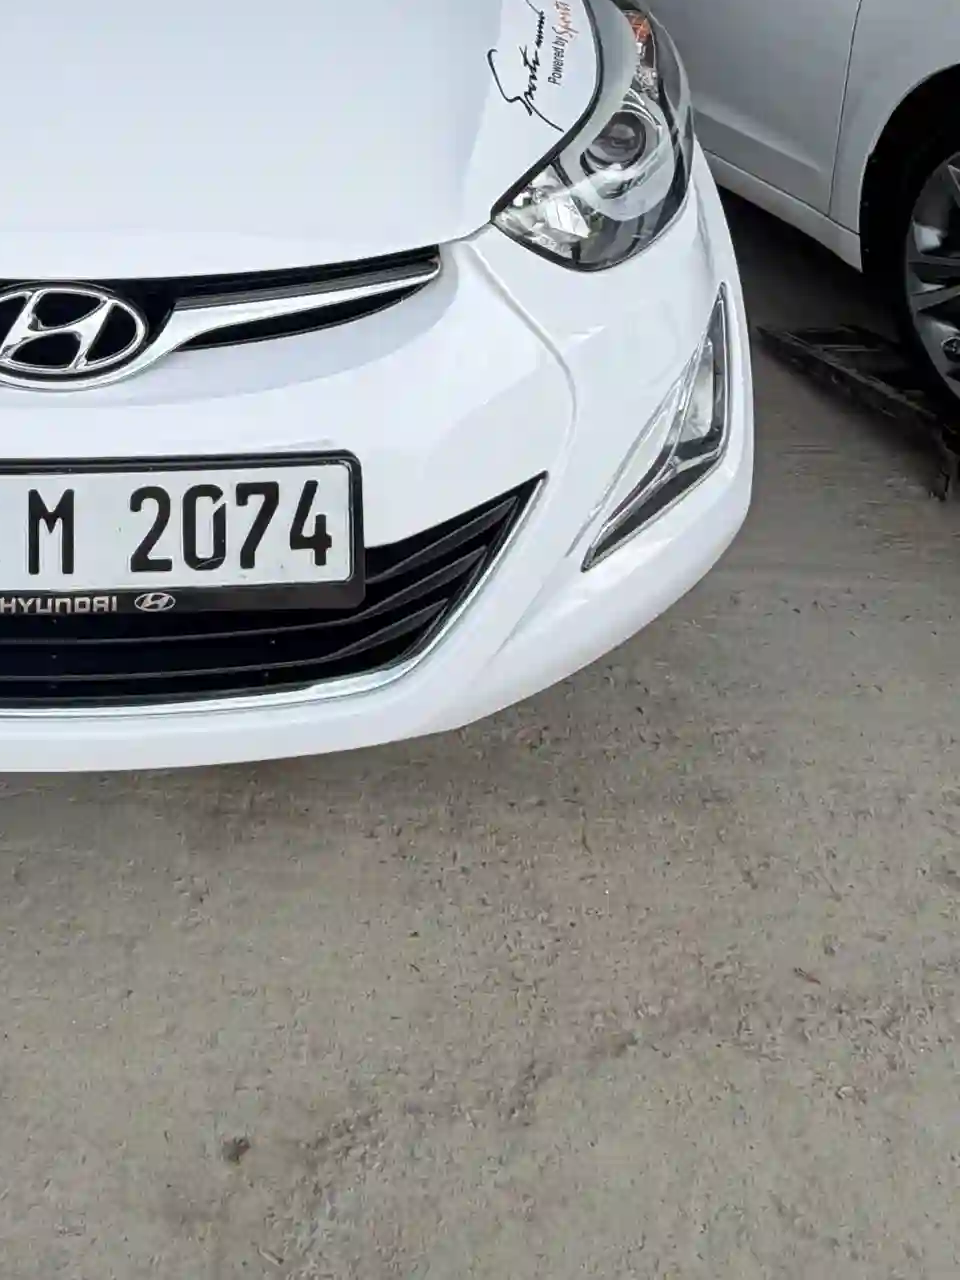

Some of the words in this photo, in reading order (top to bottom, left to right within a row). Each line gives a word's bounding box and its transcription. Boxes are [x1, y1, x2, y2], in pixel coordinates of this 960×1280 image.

[547, 48, 566, 86] Powered
[28, 489, 75, 575] M
[129, 480, 333, 573] 2074
[0, 596, 118, 614] HYUNDAI
